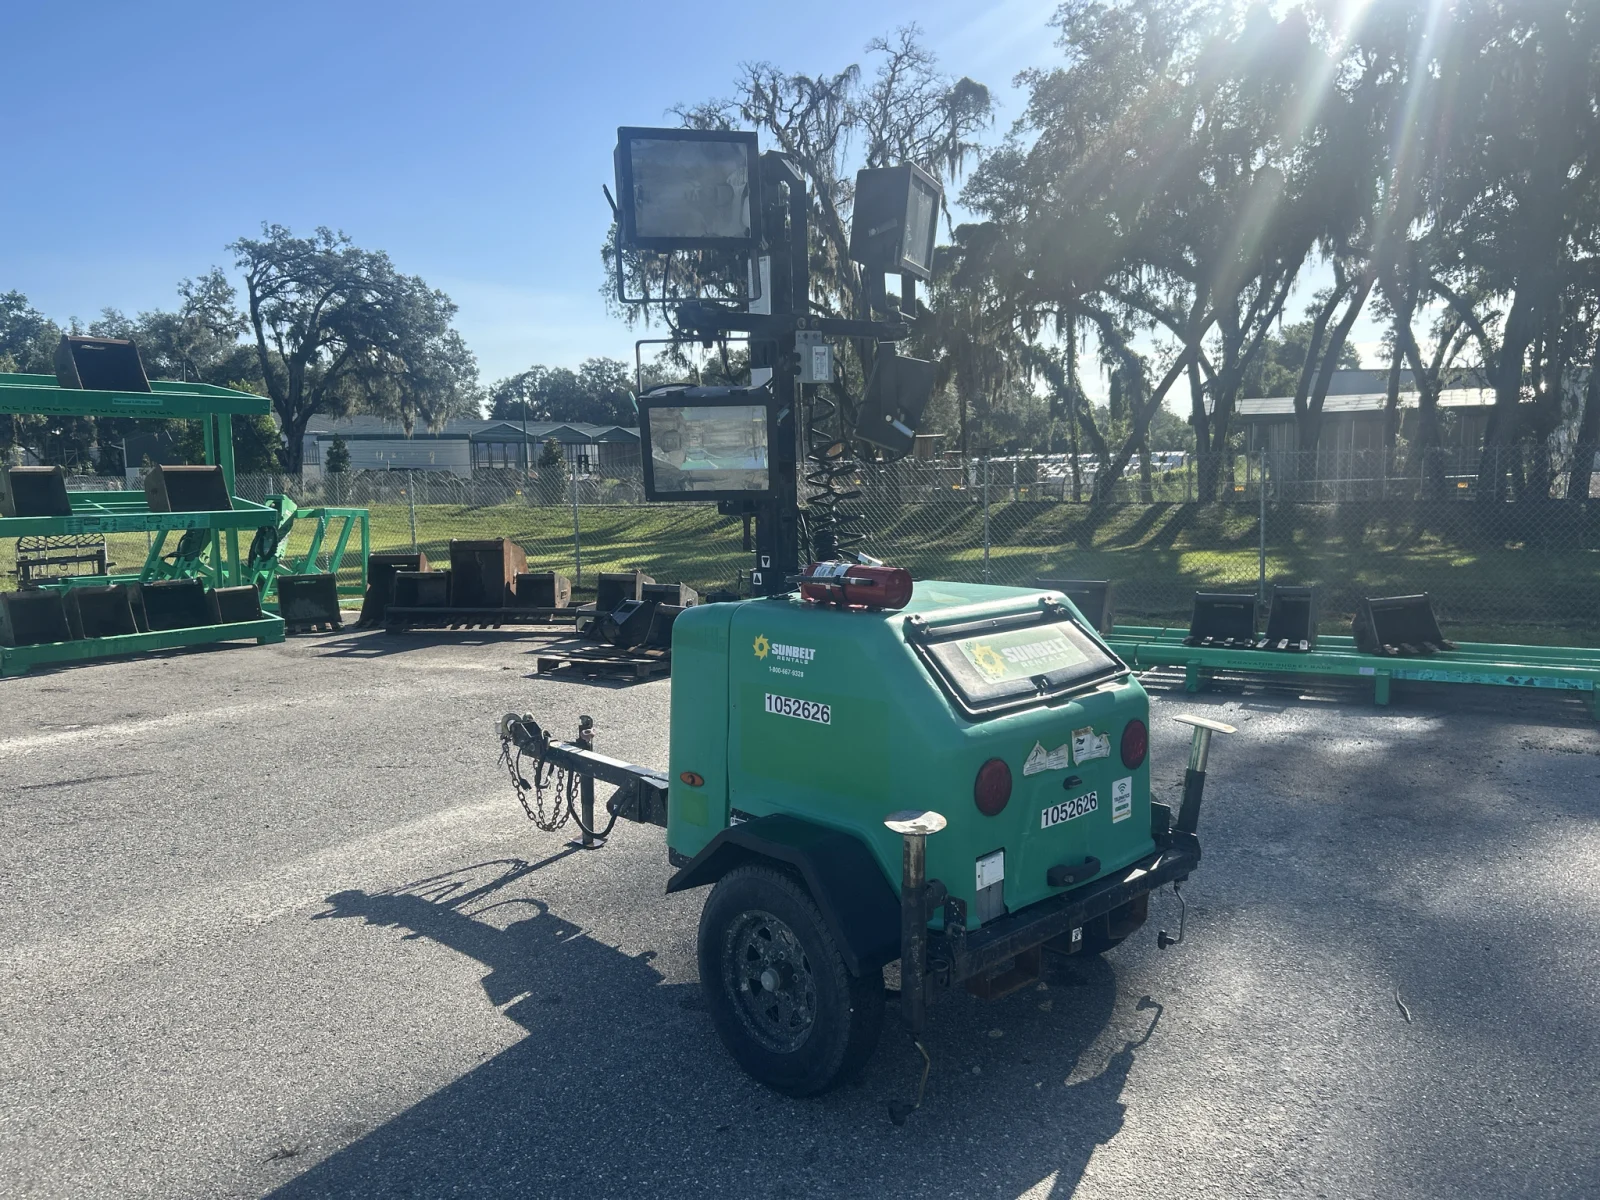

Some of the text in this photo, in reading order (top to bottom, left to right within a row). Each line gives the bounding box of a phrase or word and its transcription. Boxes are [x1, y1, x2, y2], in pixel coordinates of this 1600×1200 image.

[771, 643, 816, 661] SUNBELT
[777, 655, 809, 665] RENTALS
[1001, 637, 1069, 663] SUNBELT
[1020, 652, 1068, 668] RENTALS
[766, 694, 830, 723] 1052626
[1043, 792, 1097, 826] 1052626
